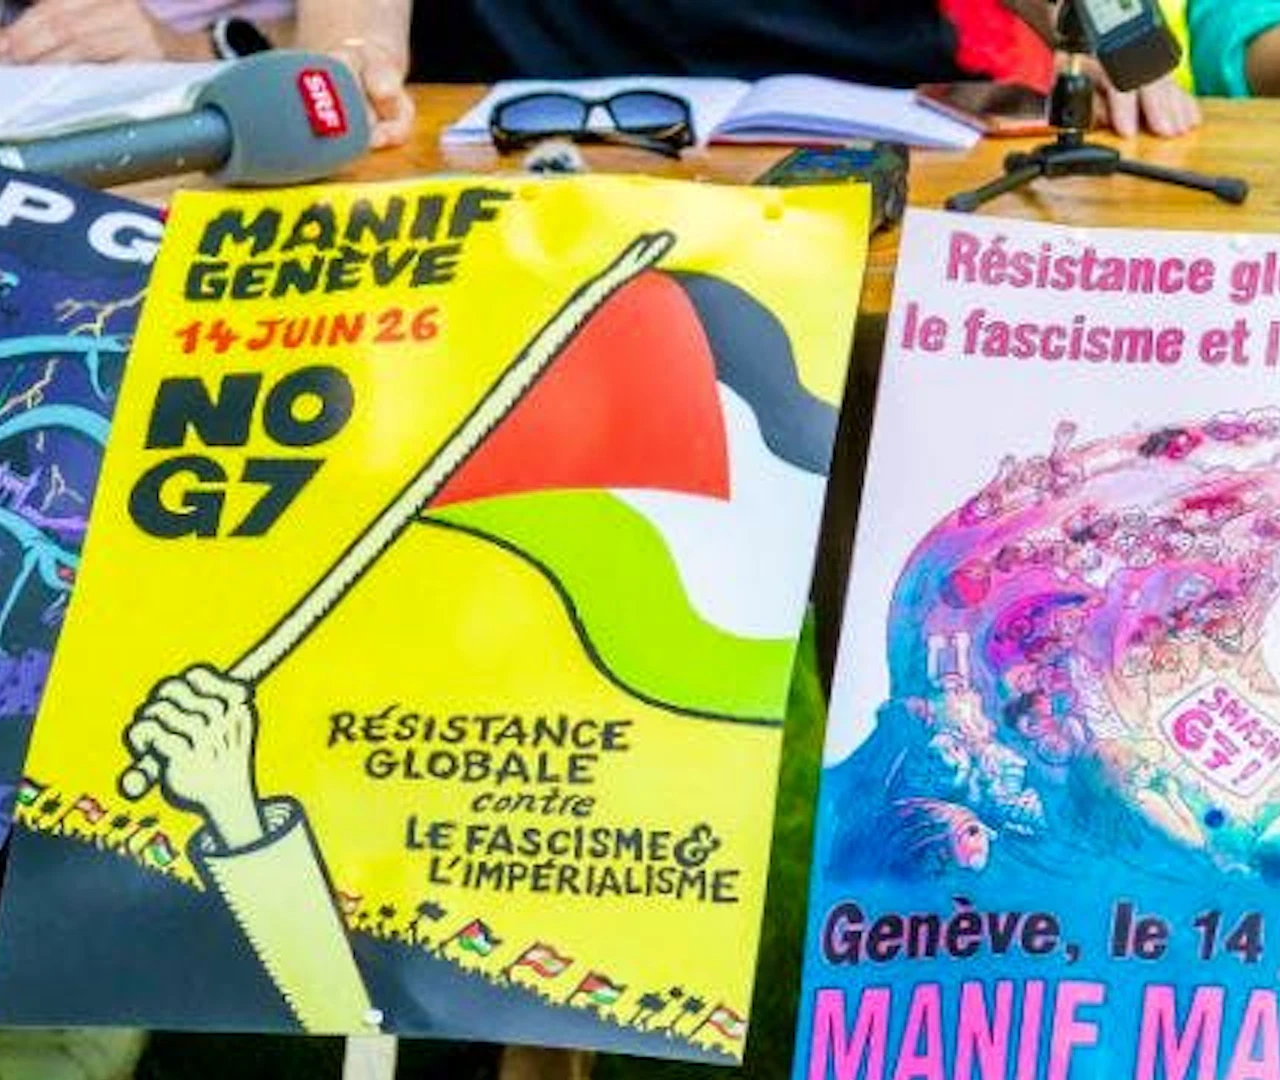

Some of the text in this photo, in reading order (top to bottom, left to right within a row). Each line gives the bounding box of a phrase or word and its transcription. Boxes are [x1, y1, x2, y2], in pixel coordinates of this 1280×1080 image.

[88, 211, 166, 264] G
[198, 188, 512, 258] MANIF
[185, 242, 464, 300] GENÈVE
[946, 231, 1214, 293] Résistance
[176, 306, 441, 355] 14 JUIN 26
[900, 303, 946, 353] le
[962, 307, 1186, 365] fascisme
[1199, 319, 1251, 368] et
[145, 364, 356, 450] NO
[127, 454, 326, 541] G7
[327, 704, 633, 752] RÉSISTANCE
[364, 750, 598, 785] GLOBALE
[472, 786, 596, 818] contre
[405, 816, 722, 869] LE FASCISME &
[429, 855, 739, 903] L'IMPÉRIALISME
[822, 898, 1081, 966] Genève,
[1110, 902, 1169, 962] le
[1192, 908, 1264, 965] 14
